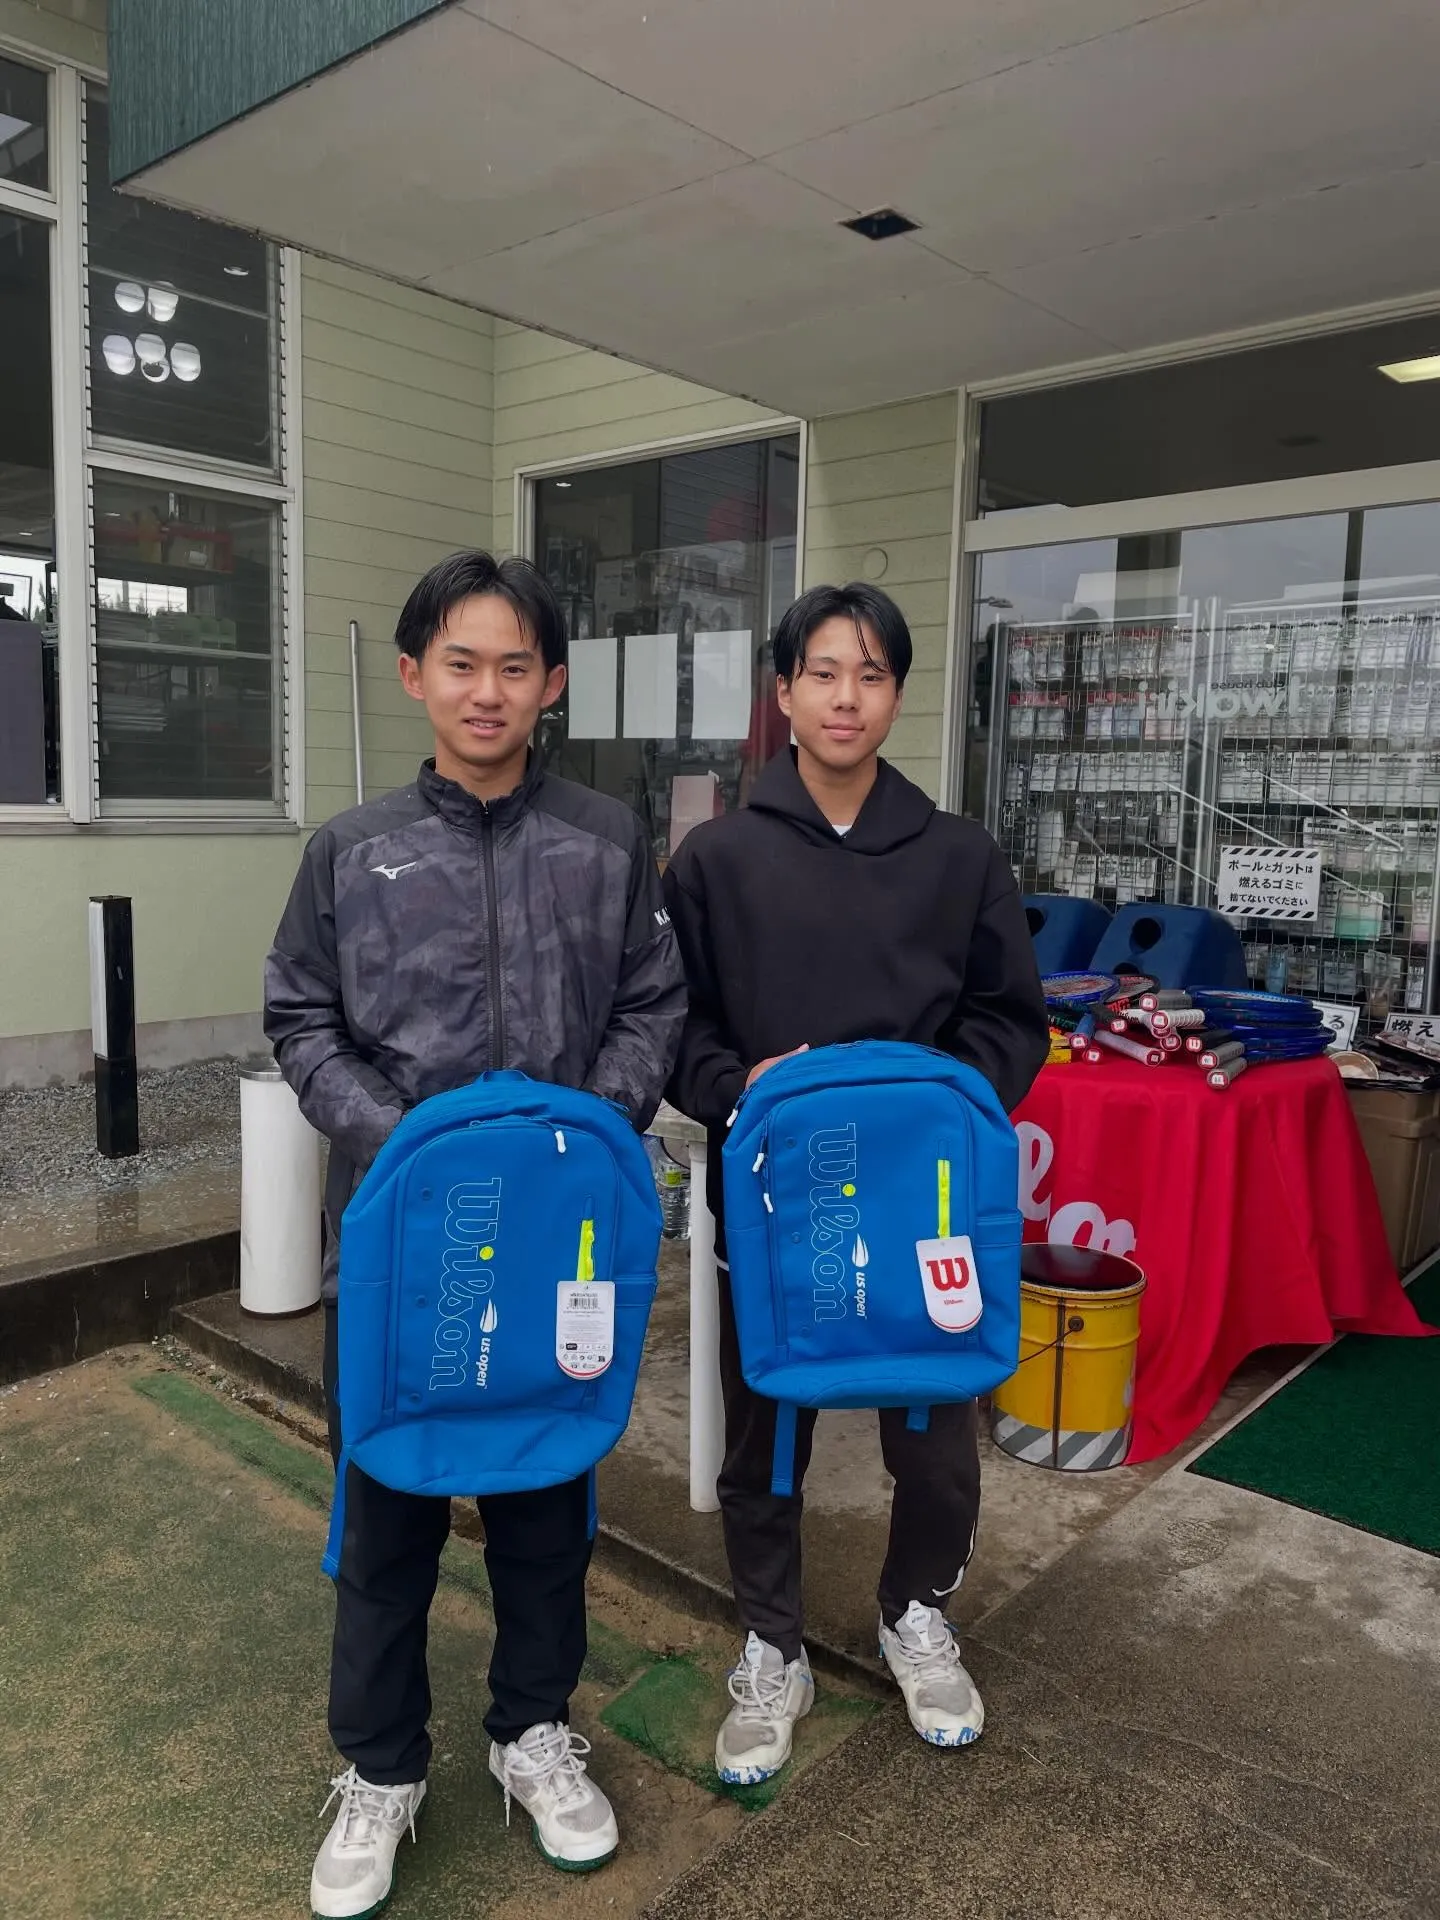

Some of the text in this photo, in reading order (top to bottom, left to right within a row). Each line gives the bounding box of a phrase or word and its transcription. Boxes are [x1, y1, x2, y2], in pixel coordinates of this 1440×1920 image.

[1228, 859, 1313, 875] ボールとガットは
[1238, 876, 1304, 891] 燃えるゴミに
[1229, 892, 1309, 906] 捨てないでください
[809, 1123, 860, 1323] Wilson
[428, 1177, 502, 1391] Wilson
[853, 1271, 867, 1317] us open
[926, 1256, 970, 1292] W
[475, 1337, 492, 1387] us open
